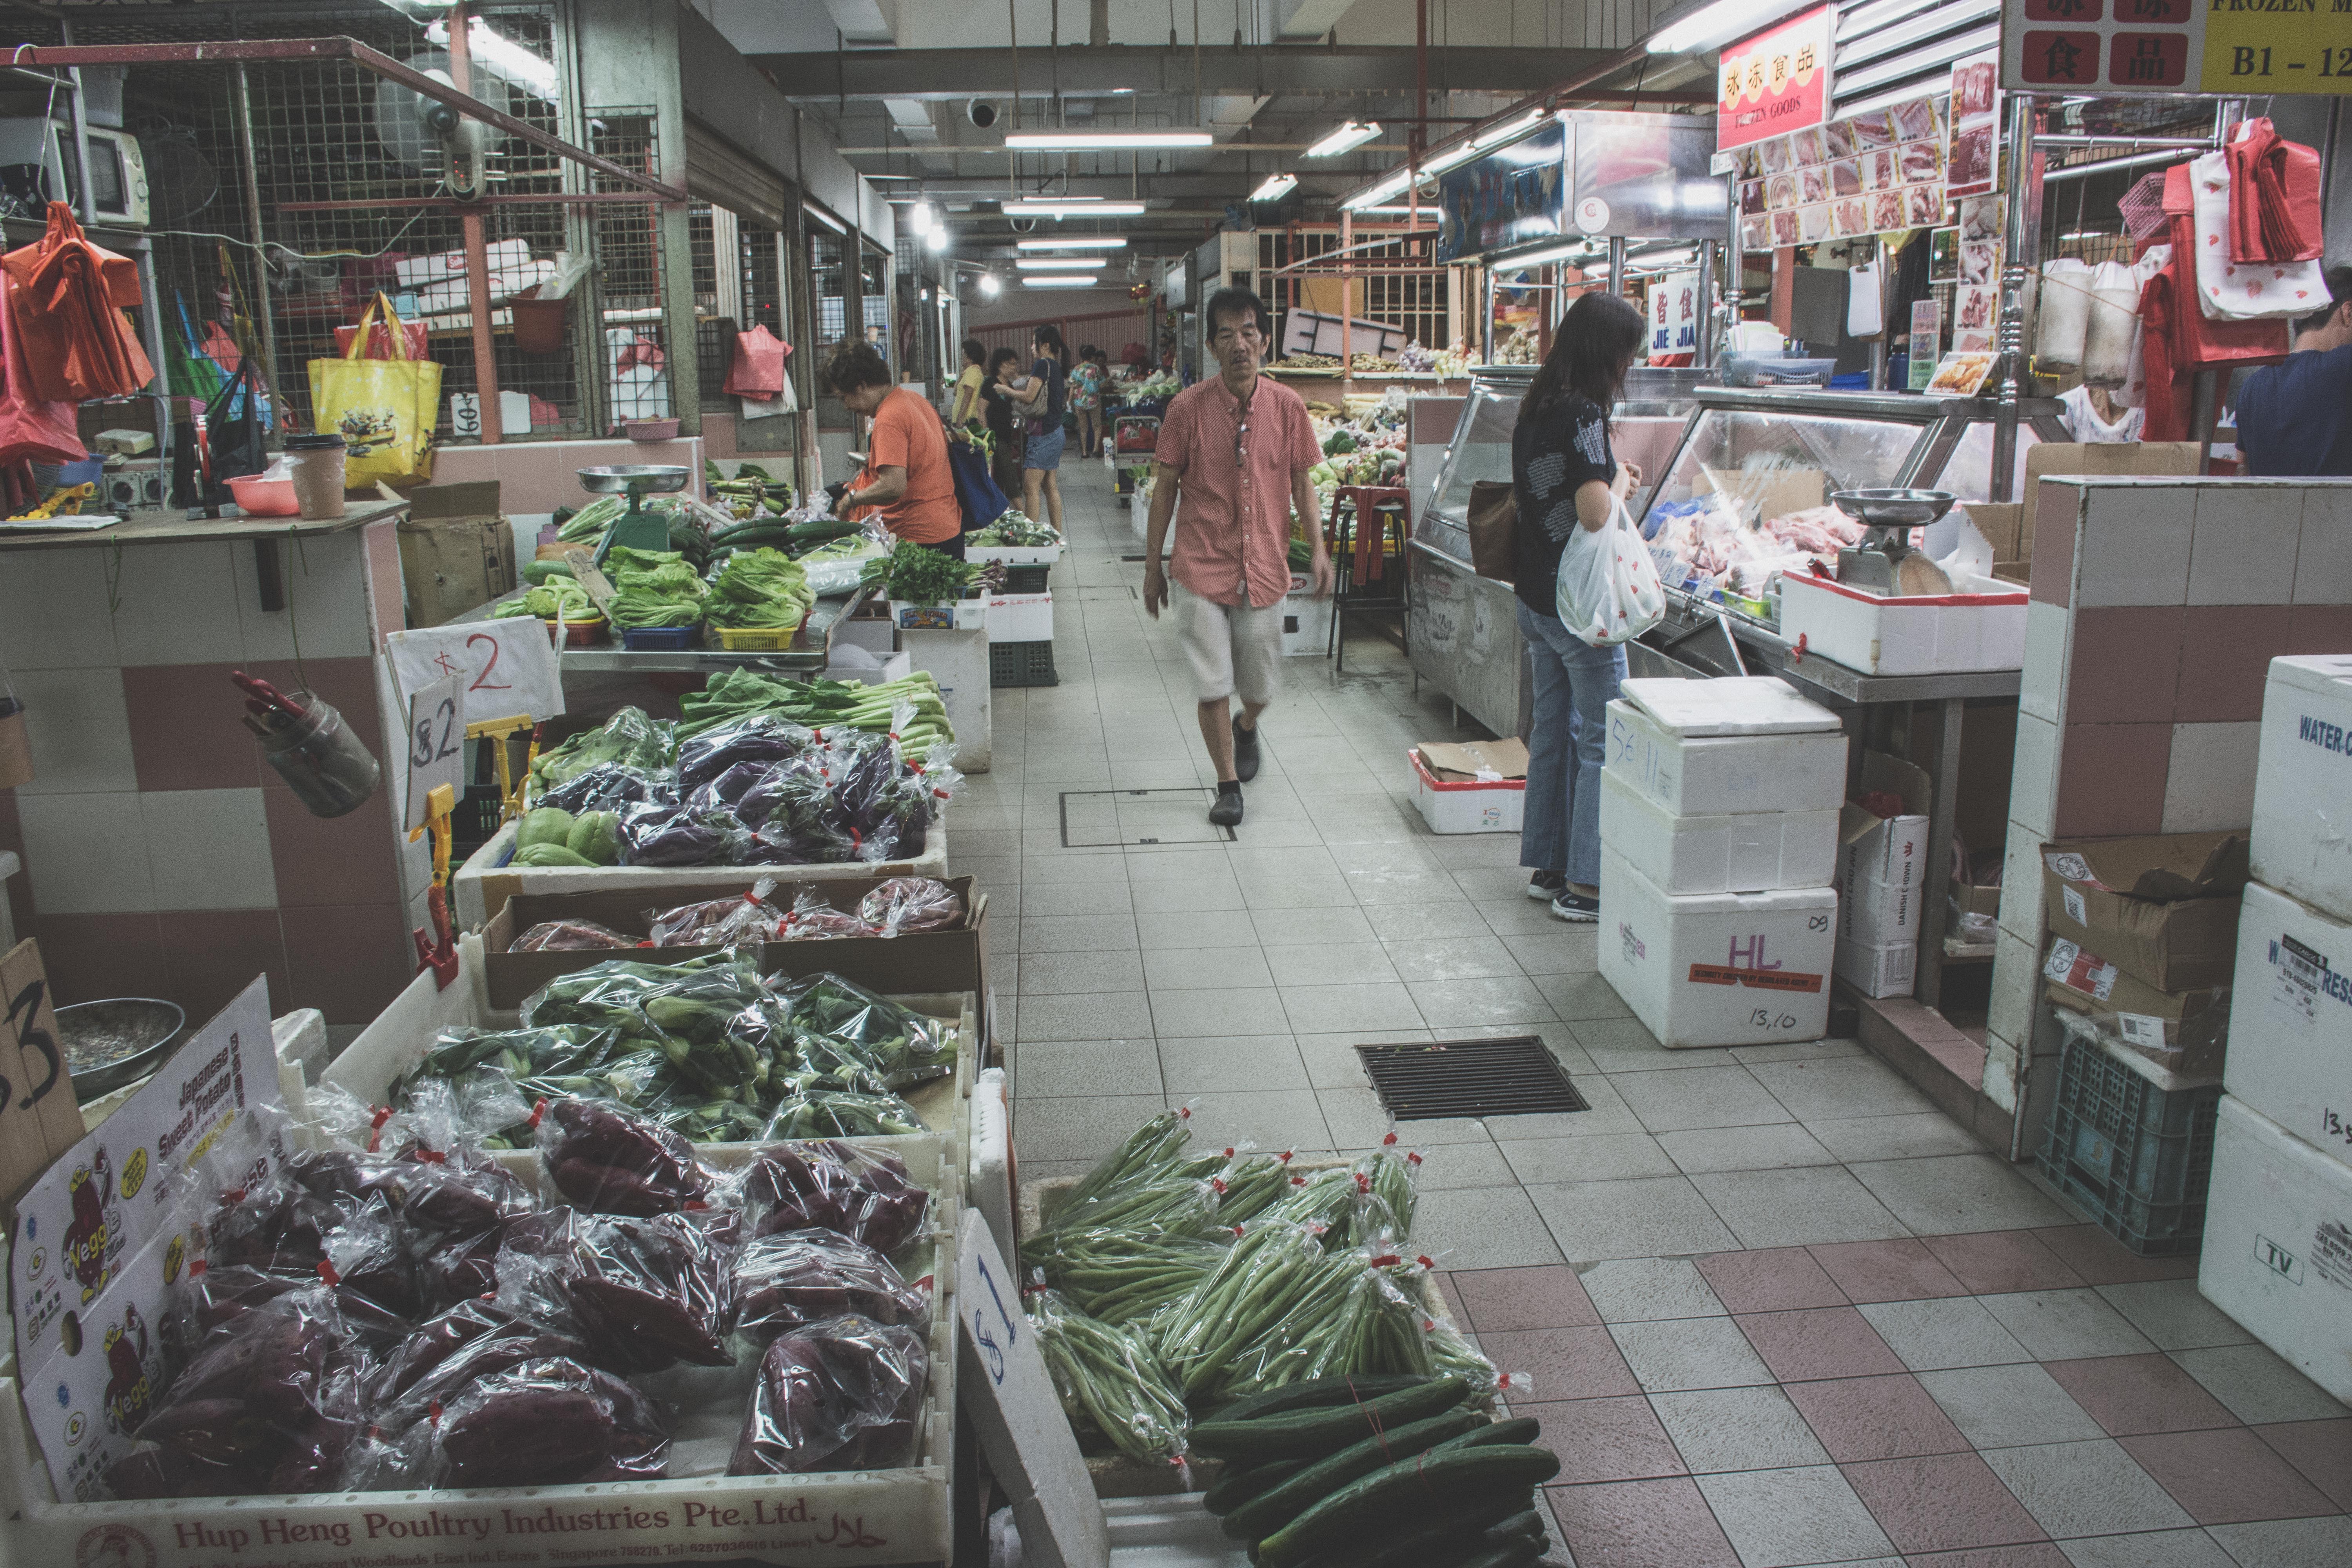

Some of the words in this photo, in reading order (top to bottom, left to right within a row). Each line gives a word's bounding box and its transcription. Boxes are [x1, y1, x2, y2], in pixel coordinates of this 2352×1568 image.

[2230, 46, 2273, 76] B1
[1770, 96, 1801, 118] GOODS
[2300, 715, 2343, 753] WATER
[1898, 895, 1907, 925] DANISH
[1748, 974, 1757, 982] BY
[179, 1047, 229, 1111] Japanese
[158, 1110, 193, 1161] Sweet
[195, 1072, 231, 1123] Potato
[2266, 1243, 2293, 1274] TV
[174, 1522, 249, 1553] Hup
[260, 1518, 352, 1546] Heng
[362, 1511, 490, 1540] Poultry
[501, 1506, 670, 1535] Industries
[683, 1502, 750, 1527] Pte.
[753, 1498, 817, 1524] Ltd.
[352, 1553, 428, 1568] Woodlands
[434, 1552, 464, 1564] East
[497, 1550, 540, 1563] Estate
[546, 1548, 617, 1561] Singapore
